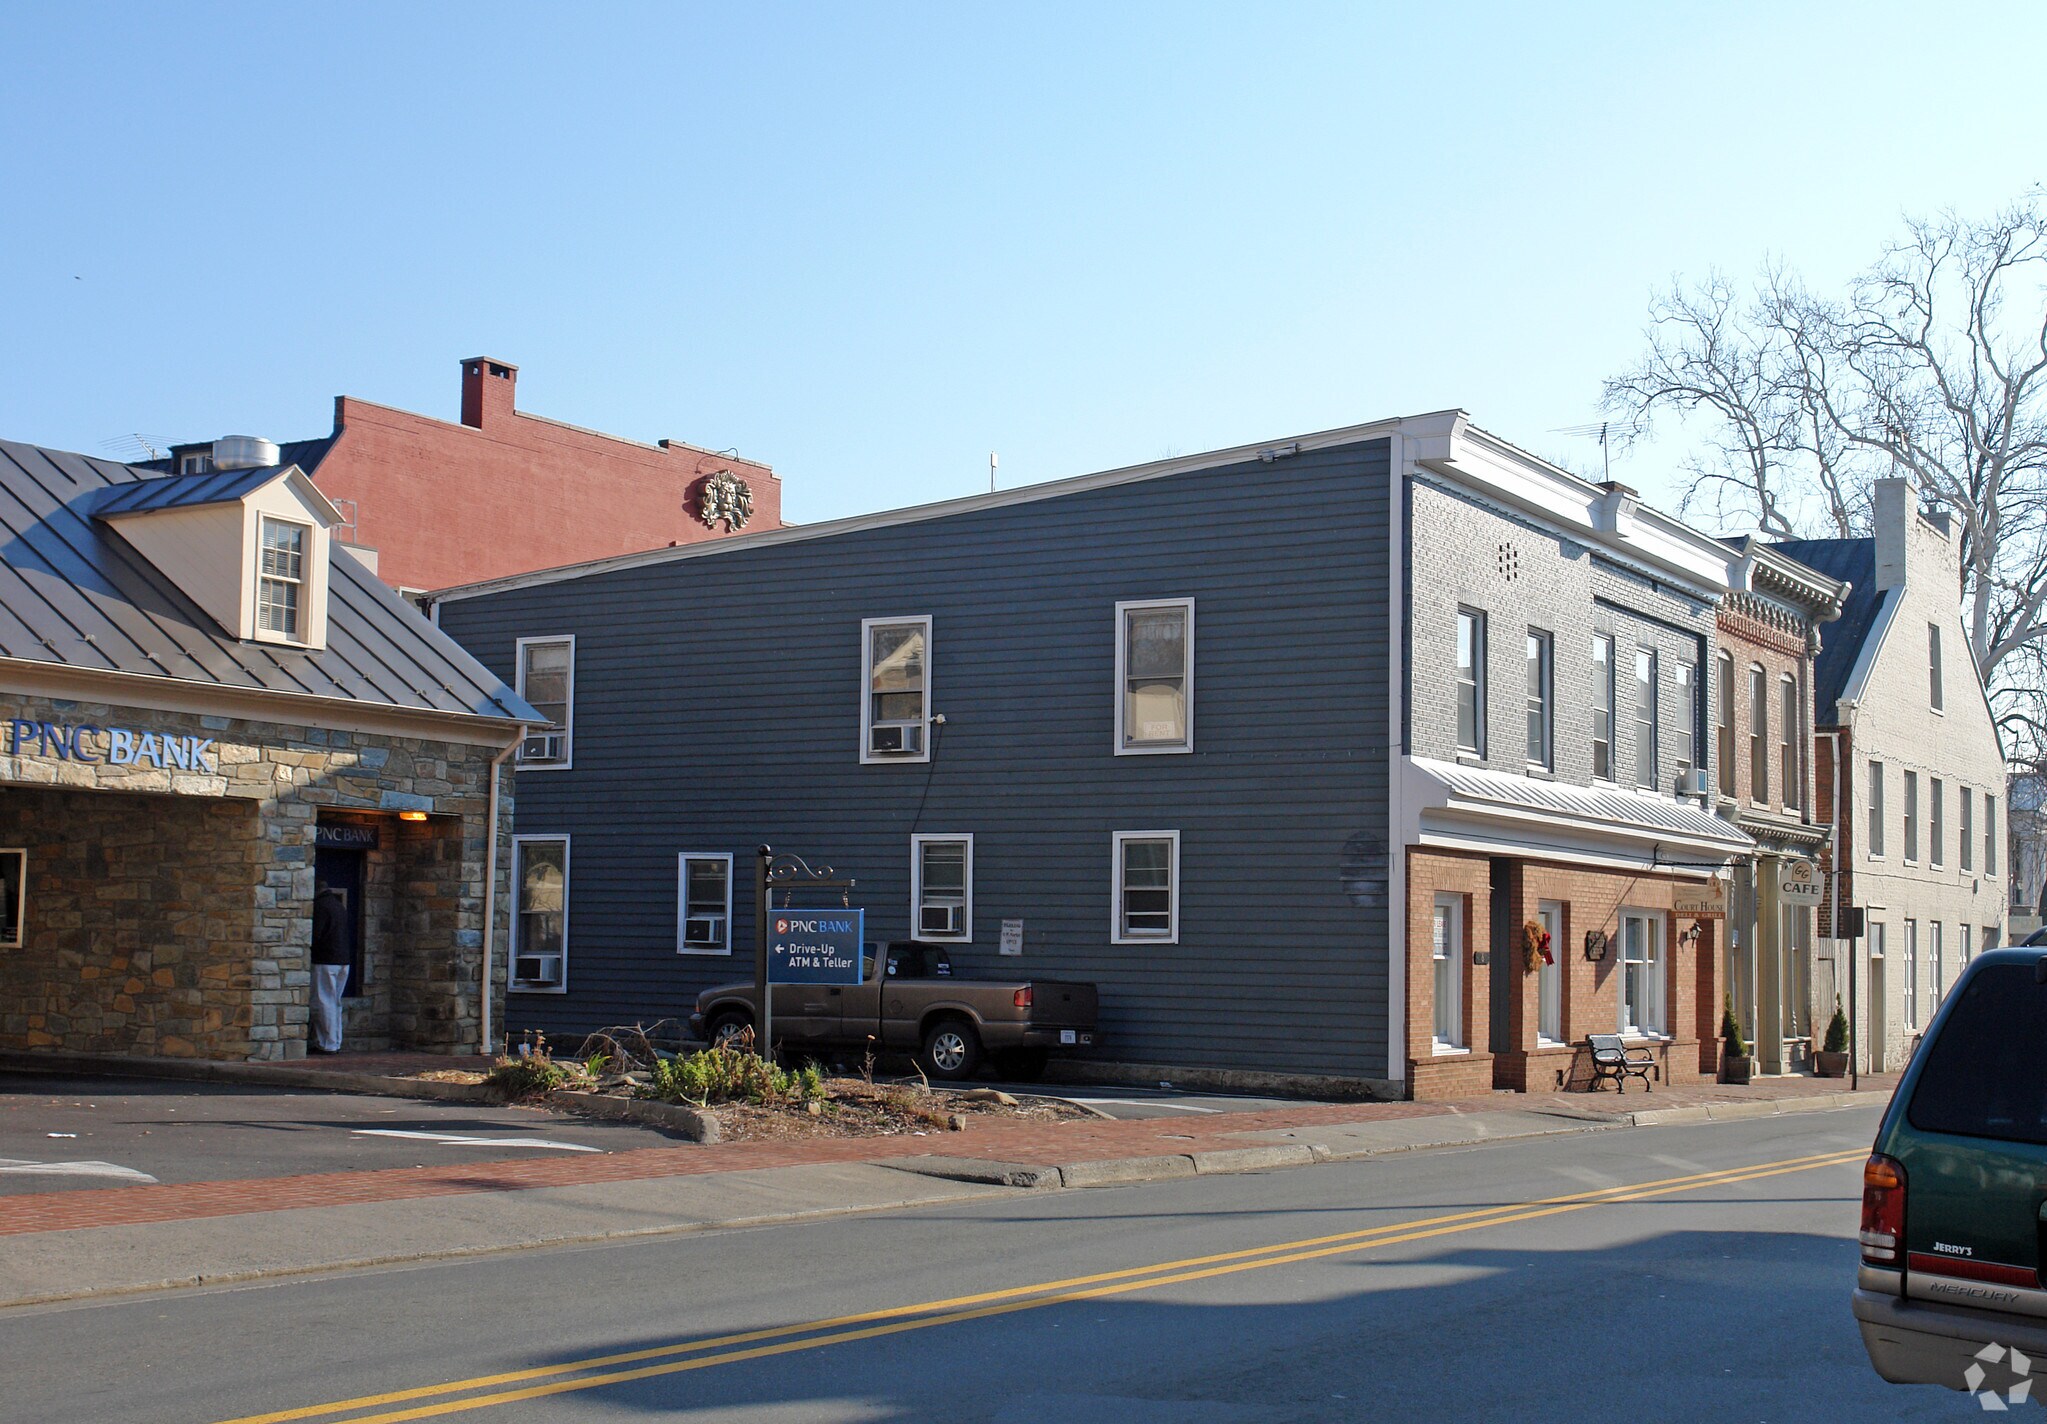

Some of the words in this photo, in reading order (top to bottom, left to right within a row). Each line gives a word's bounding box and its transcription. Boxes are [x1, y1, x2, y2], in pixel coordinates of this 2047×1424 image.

[10, 718, 100, 762] PNC
[106, 727, 215, 772] BANK
[343, 828, 374, 842] BANK
[1782, 882, 1820, 895] CAFE
[1674, 899, 1698, 911] COURT
[1700, 901, 1724, 912] HOUSE
[790, 920, 817, 933] PNC
[819, 921, 853, 933] BANK
[789, 943, 835, 956] Drive-Up
[789, 957, 810, 968] ATM
[812, 957, 820, 968] &
[824, 957, 853, 968] Teller
[1933, 1241, 1972, 1256] JERRY'S
[1930, 1282, 2019, 1302] MERCURY
